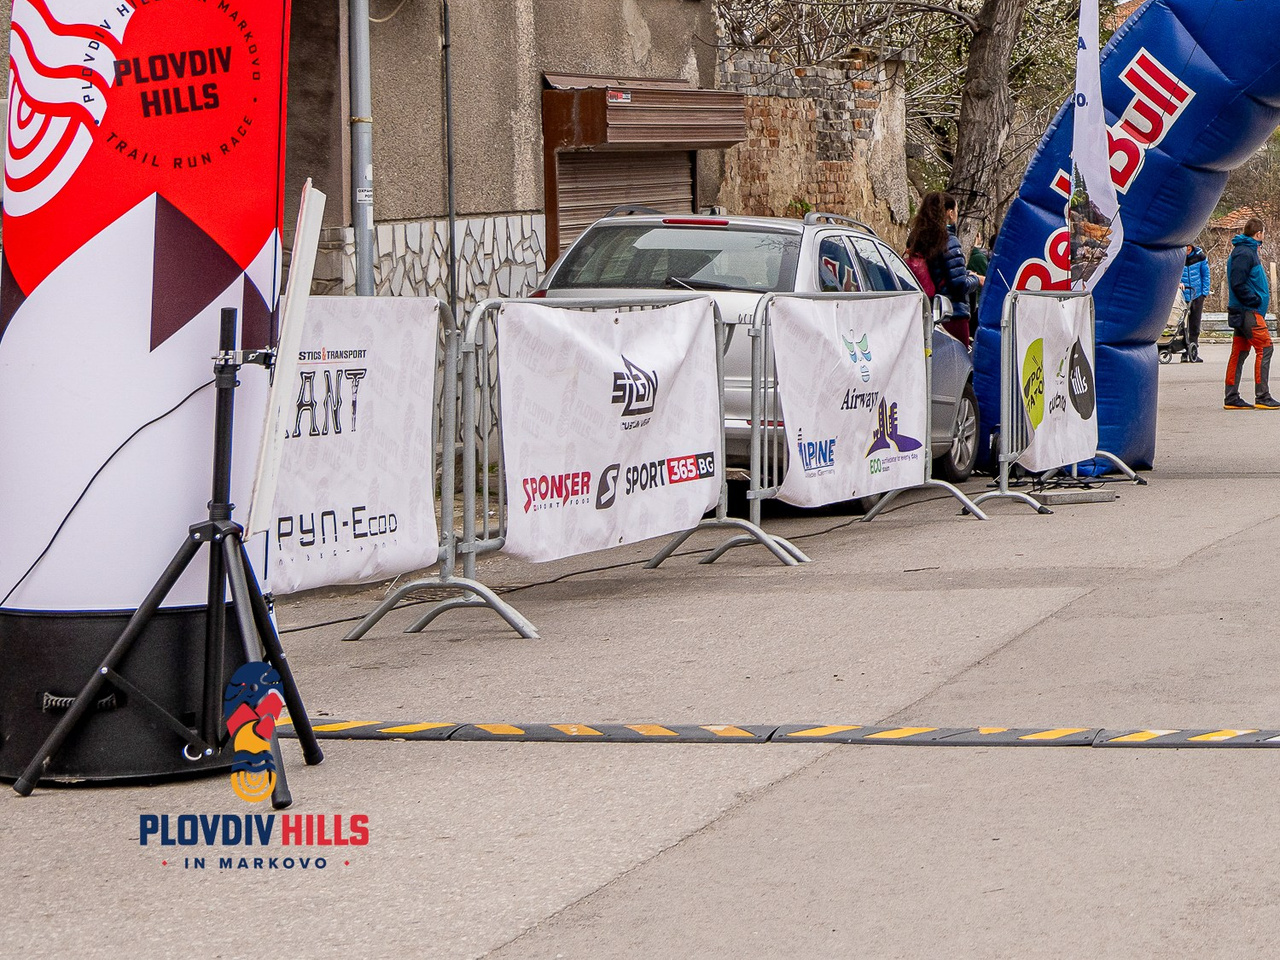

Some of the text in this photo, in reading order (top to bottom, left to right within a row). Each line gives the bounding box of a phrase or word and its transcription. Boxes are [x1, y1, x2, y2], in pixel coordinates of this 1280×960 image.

[81, 18, 112, 103] PLOVDIV
[217, 0, 260, 81] MARKOVO
[113, 46, 232, 87] PLOVDIV
[140, 83, 220, 118] HILLS
[1106, 52, 1191, 190] Bull
[106, 116, 253, 169] TRAIL RUN RACE
[284, 368, 367, 439] ANT
[522, 471, 592, 514] SPONSER
